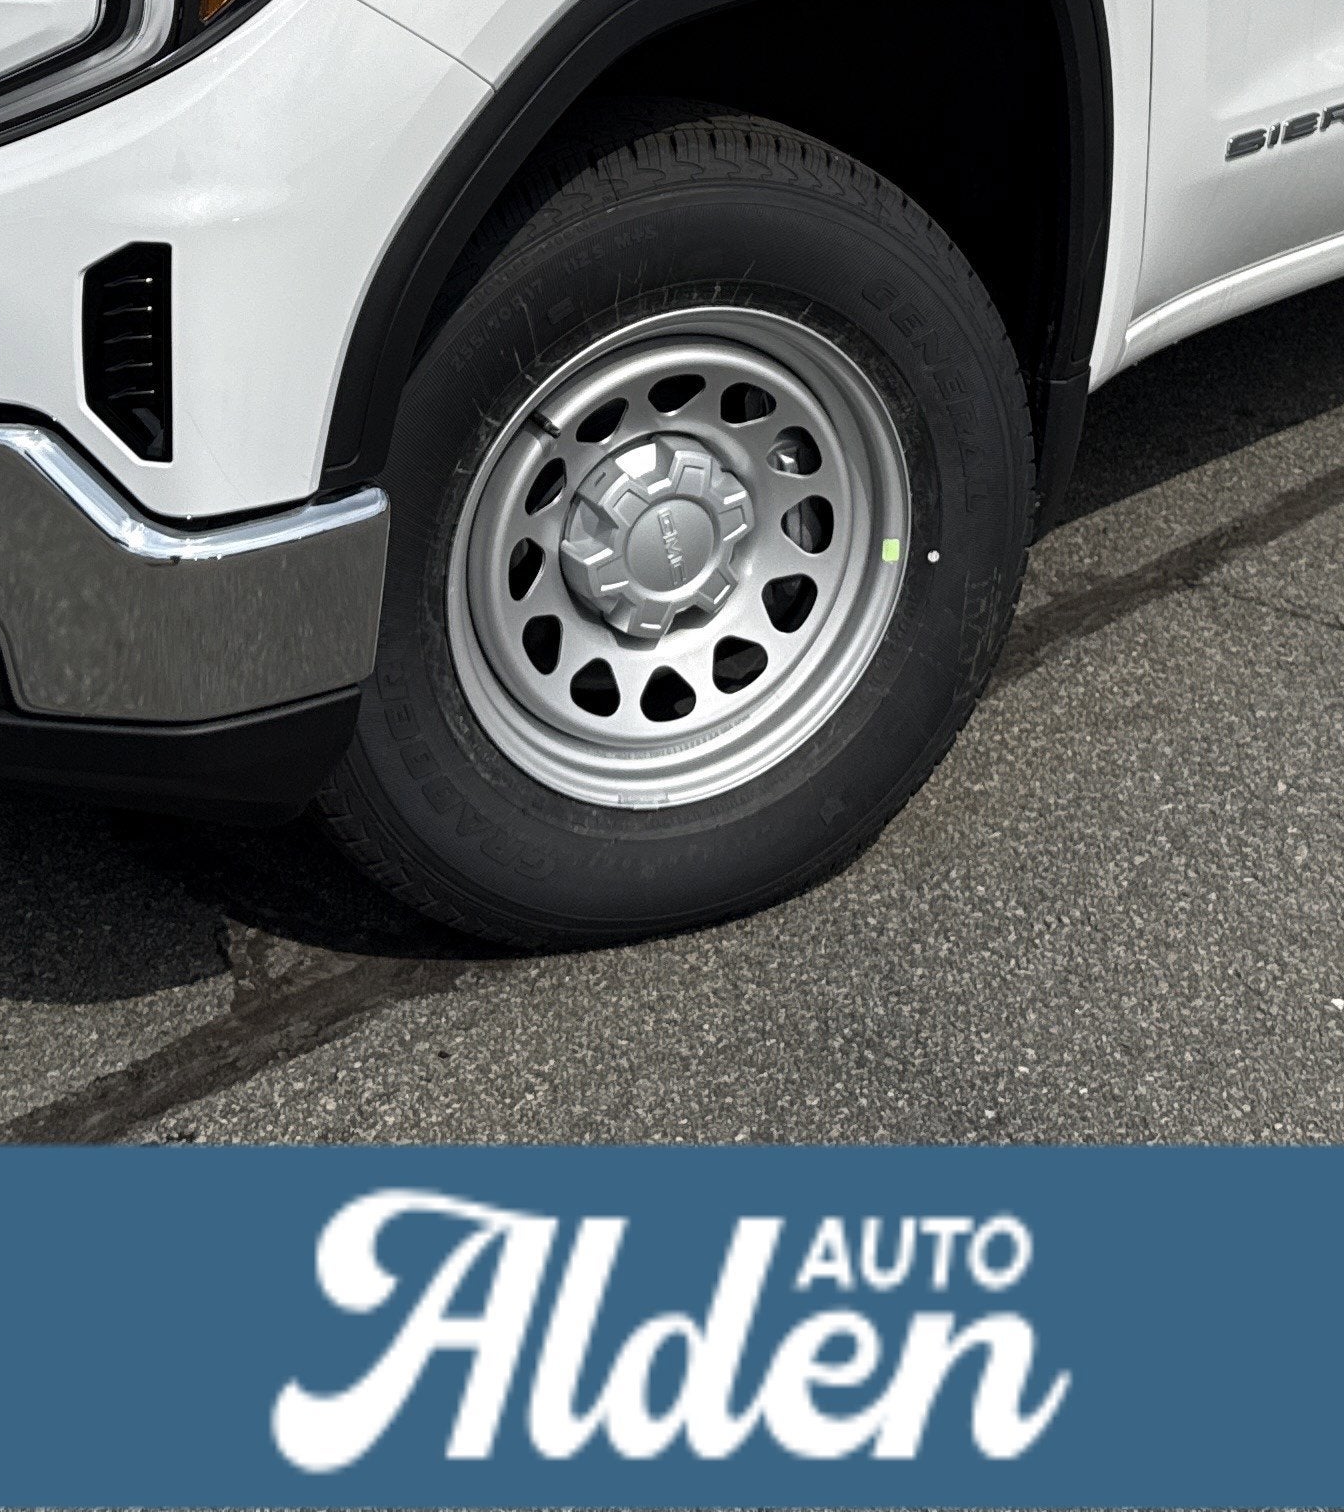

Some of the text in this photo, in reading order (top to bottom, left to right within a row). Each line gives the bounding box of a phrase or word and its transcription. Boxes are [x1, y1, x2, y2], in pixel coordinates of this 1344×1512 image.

[862, 278, 987, 513] GENERAL
[658, 508, 687, 586] GMC
[376, 662, 555, 881] GRABBER
